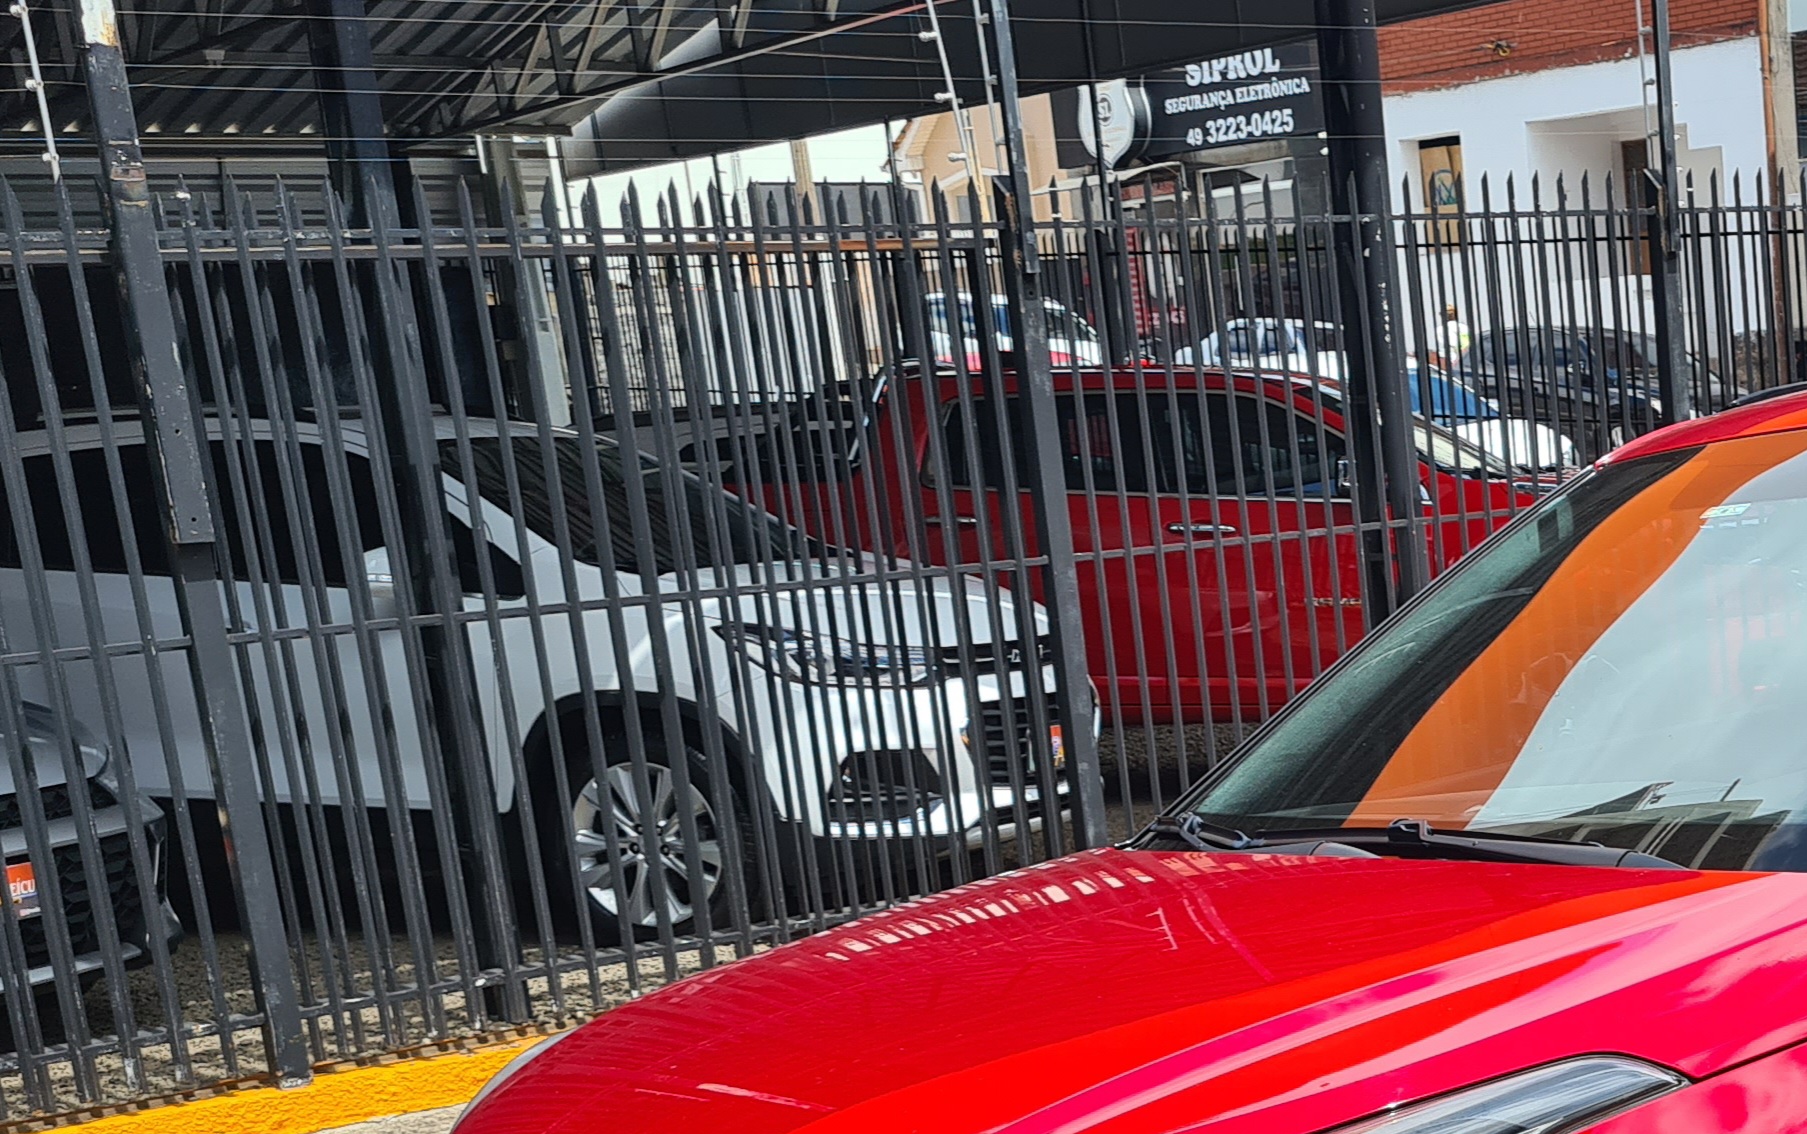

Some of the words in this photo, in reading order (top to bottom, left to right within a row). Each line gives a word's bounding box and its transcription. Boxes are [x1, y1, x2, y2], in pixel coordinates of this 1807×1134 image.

[1164, 88, 1234, 115] SEGURANÇA
[1235, 76, 1311, 106] ELETRÔNICA
[1186, 127, 1203, 147] 49
[1205, 108, 1295, 144] 3223-0425
